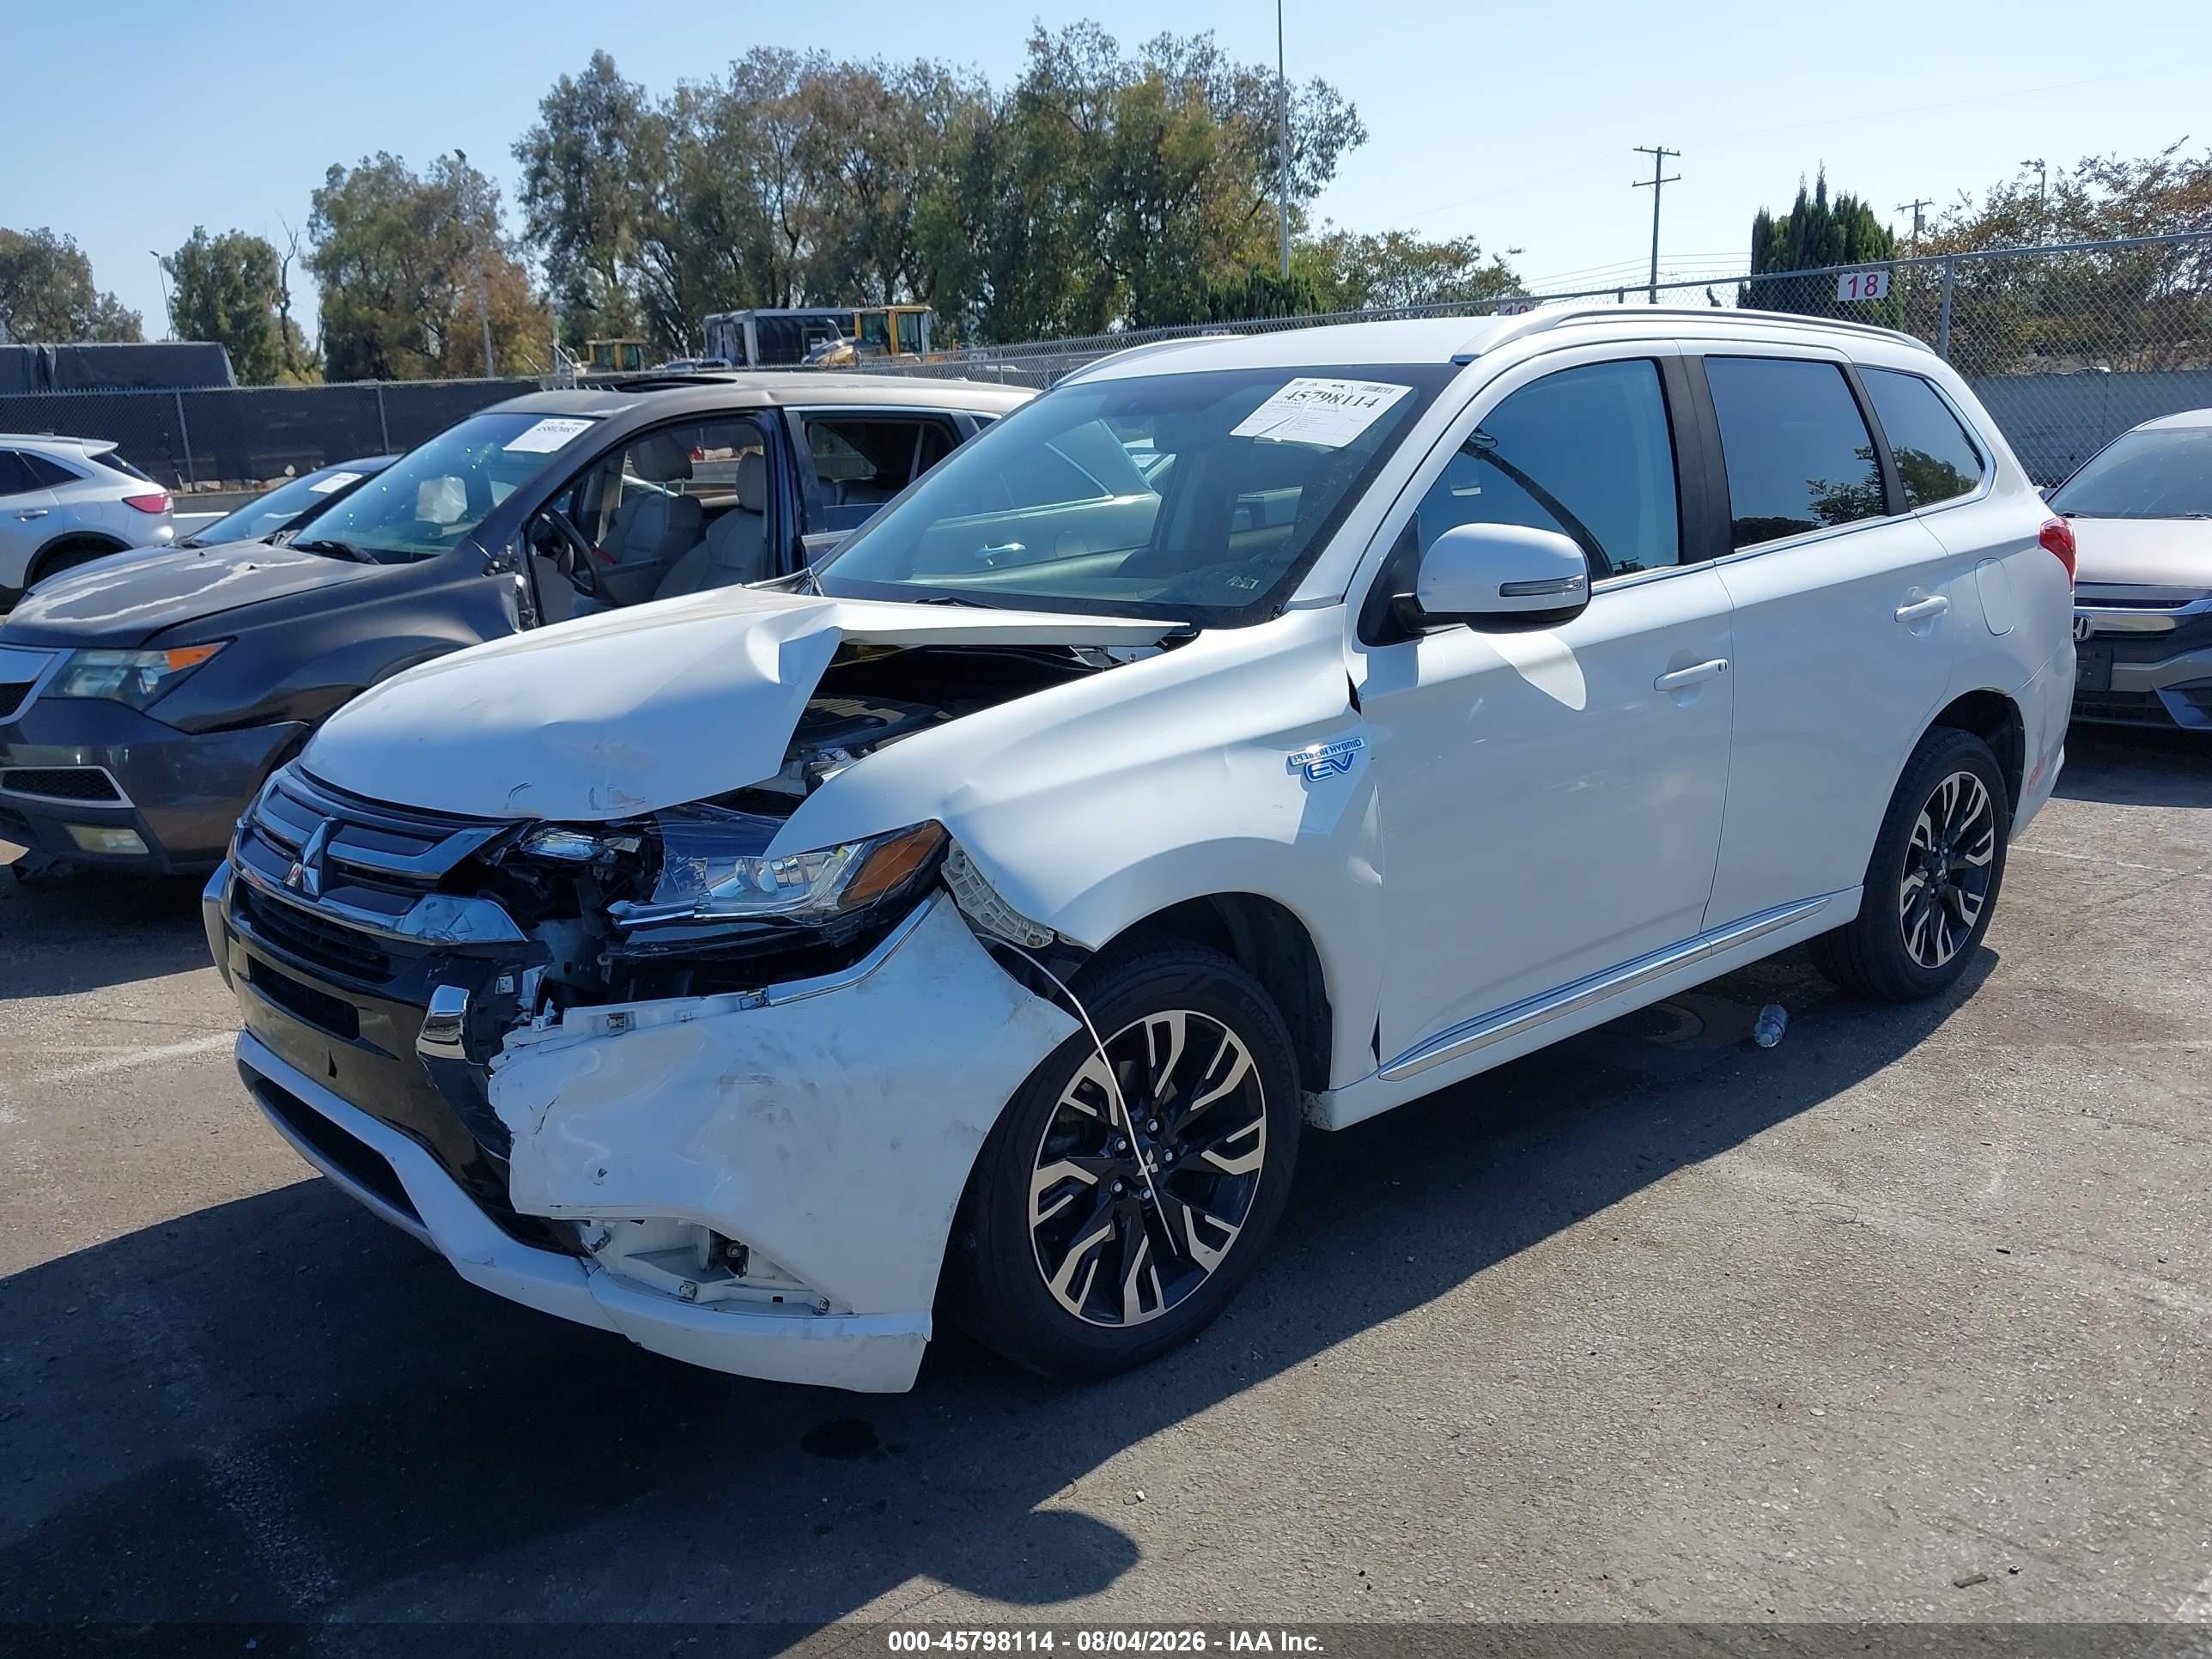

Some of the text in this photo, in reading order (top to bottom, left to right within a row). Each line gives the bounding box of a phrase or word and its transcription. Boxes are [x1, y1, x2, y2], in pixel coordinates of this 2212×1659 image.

[1848, 274, 1879, 298] 18
[1285, 390, 1381, 408] 45798114
[1330, 738, 1363, 754] HYBRID
[1305, 751, 1355, 781] EV
